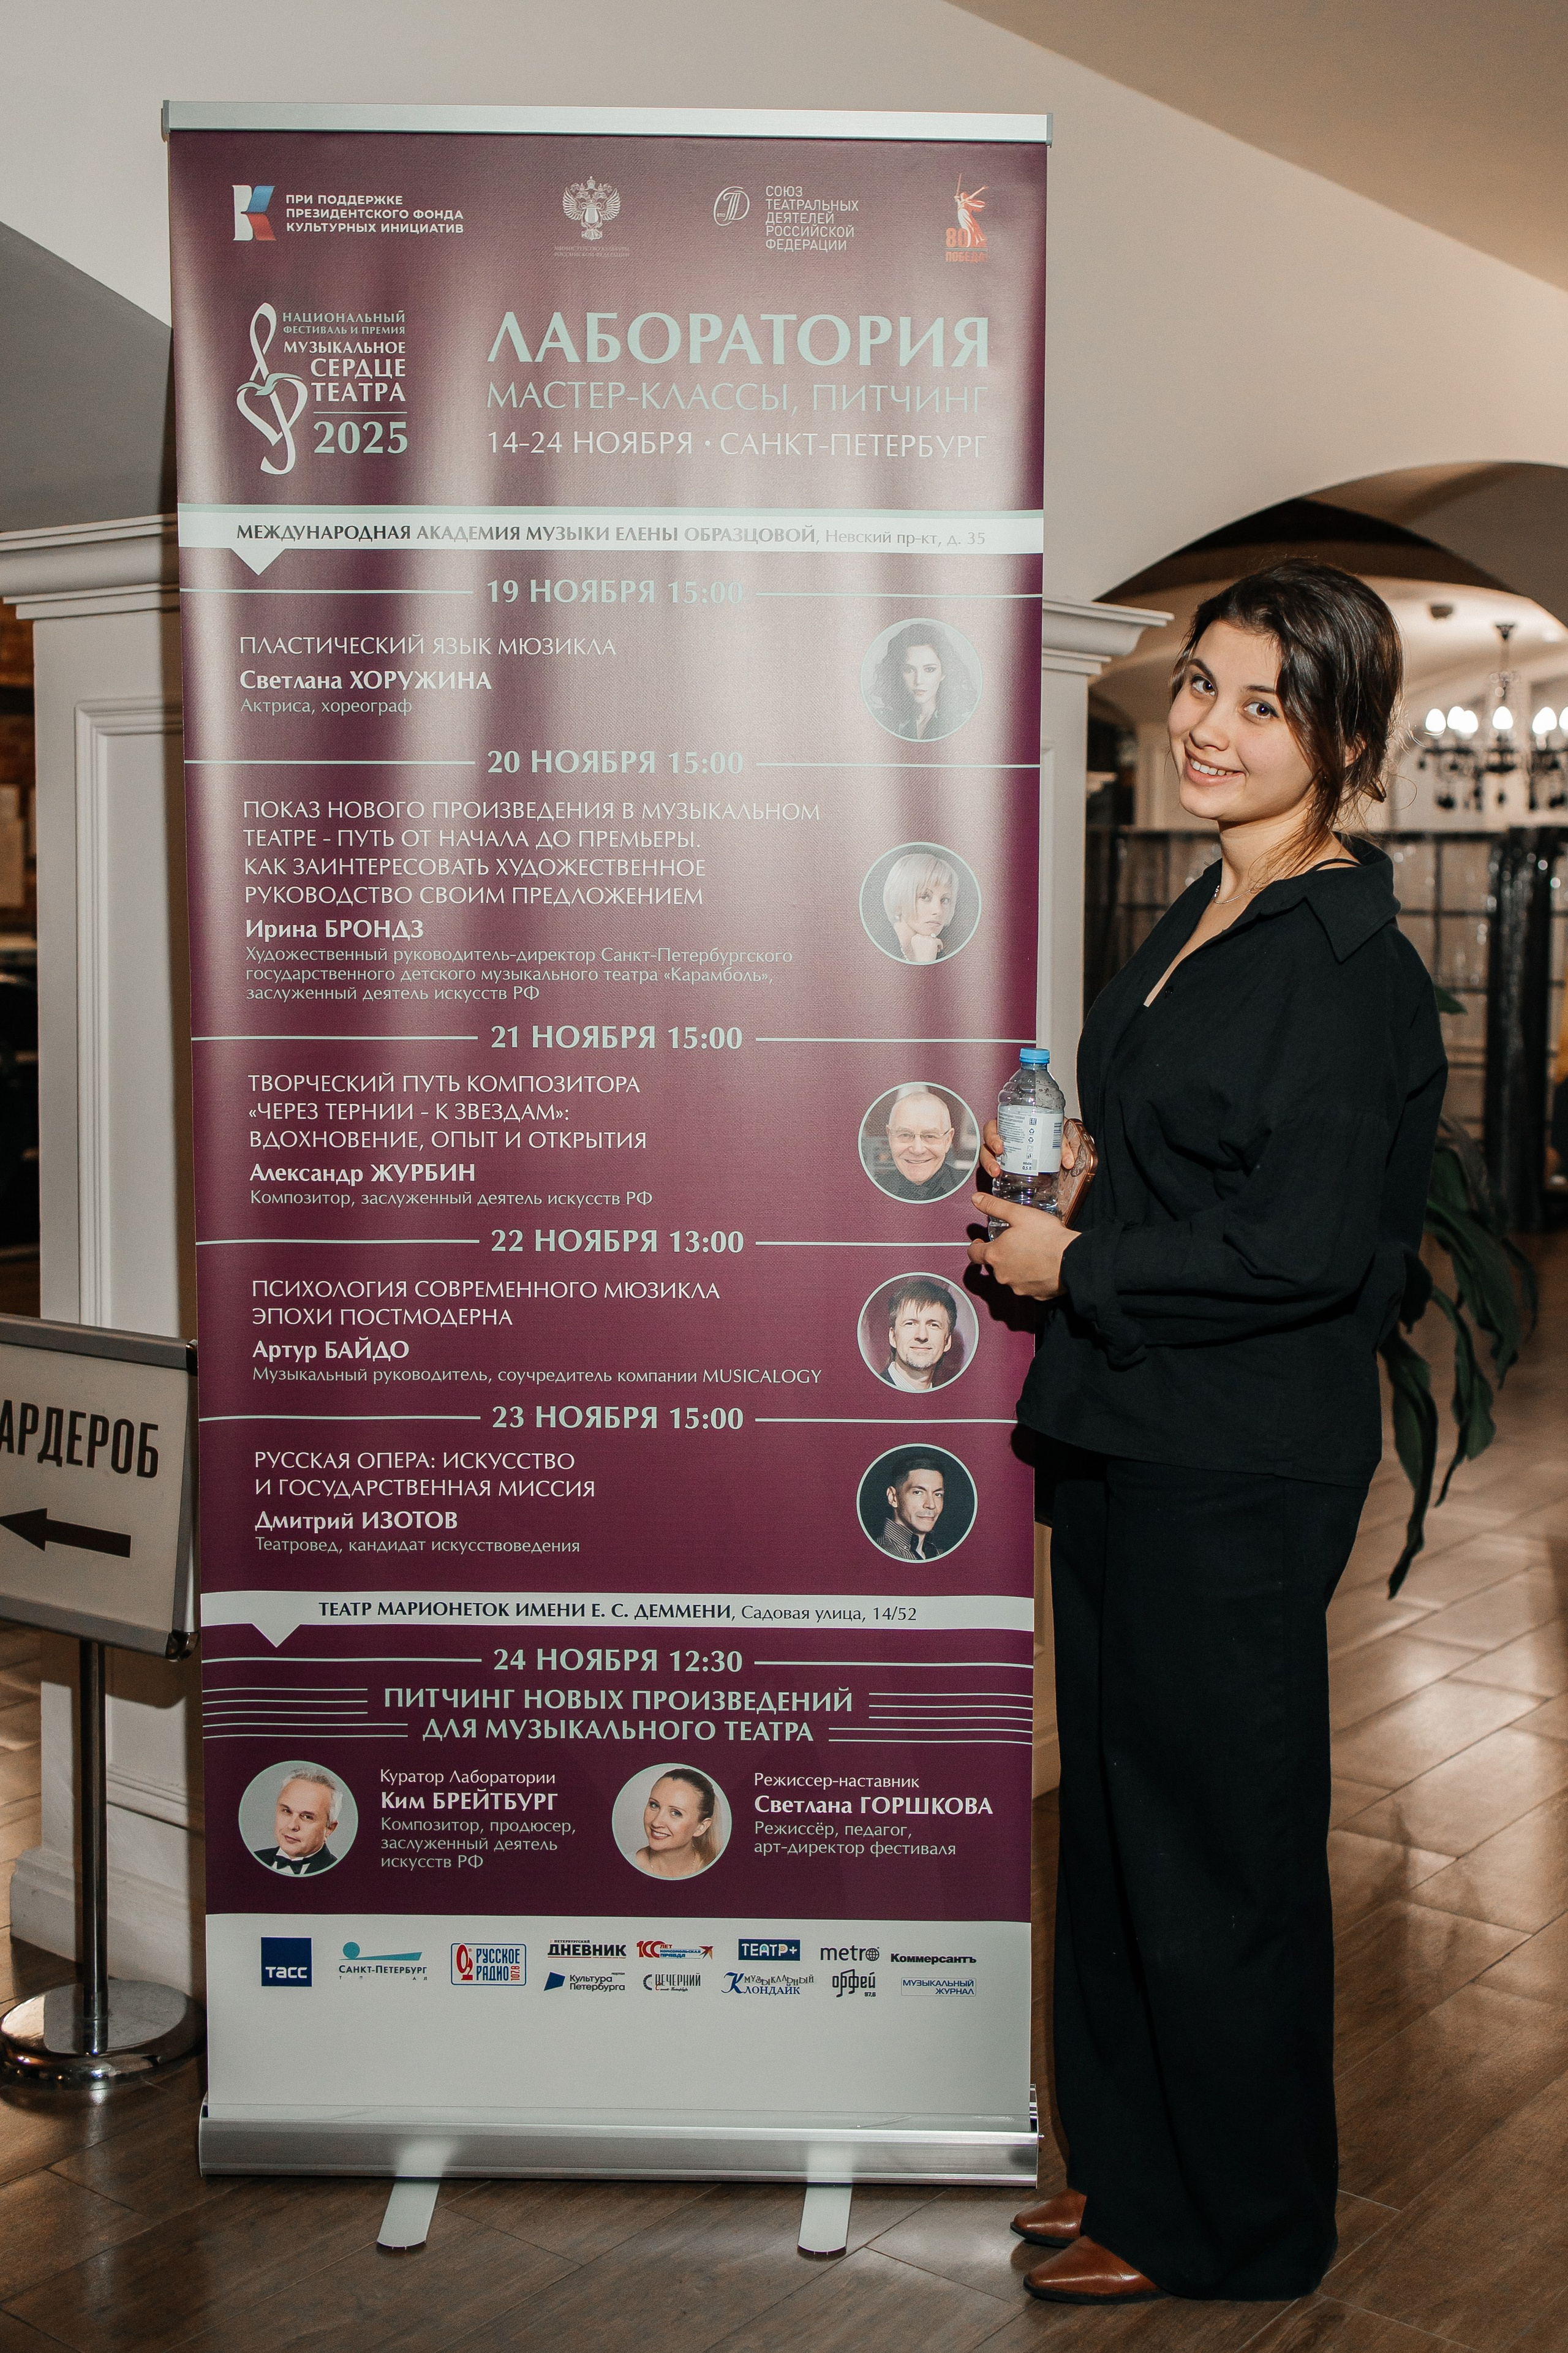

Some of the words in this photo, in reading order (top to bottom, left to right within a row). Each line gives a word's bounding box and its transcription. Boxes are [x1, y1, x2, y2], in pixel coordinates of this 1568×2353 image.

[286, 195, 312, 203] ПРИ
[318, 195, 402, 205] ПОДДЕРЖКЕ
[766, 186, 802, 197] СОЮЗ
[287, 208, 409, 219] ПРЕЗИДЕНТСКОГО
[413, 210, 463, 220] ФОНДА
[766, 198, 858, 213] ТЕАТРАЛЬНЫХ
[765, 211, 834, 225] ДЕЯТЕЛЕЙ
[287, 223, 376, 232] КУЛЬТУРНЫХ
[381, 224, 463, 234] ИНИЦИАТИВ
[766, 225, 854, 237] РОССИЙСКОЙ
[766, 239, 846, 252] ФЕДЕРАЦИИ
[283, 310, 404, 322] НАЦИОНАЛЬНЫЙ
[284, 341, 405, 353] МУЗЫКАЛЬНОЕ
[488, 312, 988, 369] ЛАБОРАТОРИЯ
[311, 358, 405, 379] СЕРДЦЕ
[311, 383, 405, 401] ТЕАТРА
[488, 381, 797, 416] МАСТЕР-КЛАССЫ,
[813, 384, 988, 414] ПИТЧИНГ
[314, 421, 407, 453] 2025
[489, 431, 562, 453] 14-24
[575, 431, 692, 454] НОЯБРЯ
[720, 432, 987, 458] САНКТ-ПЕТЕРБУРГ
[237, 525, 410, 541] МЕЖДУНАРОДНАЯ
[417, 526, 519, 541] АКАДЕМИЯ
[527, 527, 609, 541] МУЗЫКИ
[616, 527, 677, 541] ЕЛЕНЫ
[685, 525, 819, 545] ОБРАЗЦОВОЙ,
[826, 530, 891, 543] Невский
[897, 534, 941, 547] пр-кт,
[947, 535, 961, 546] д.
[968, 532, 985, 545] 35
[488, 580, 518, 602] 19
[531, 580, 654, 603] НОЯБРЯ
[669, 580, 745, 603] 15:00
[241, 635, 423, 654] ПЛАСТИЧЕСКИЙ
[433, 638, 491, 654] ЯЗЫК
[499, 638, 616, 655] МЮЗИКЛА
[241, 670, 342, 689] Светлана
[350, 671, 492, 689] ХОРУЖИНА
[241, 699, 315, 715] Актриса,
[322, 699, 412, 716] хореограф
[244, 801, 320, 818] ПОКАЗ
[328, 801, 424, 818] НОВОГО
[433, 802, 613, 821] ПРОИЗВЕДЕНИЯ
[623, 803, 634, 818] В
[643, 803, 820, 820] МУЗЫКАЛЬНОМ
[247, 920, 317, 942] Ирина
[326, 920, 423, 940] БРОНДЗ
[246, 947, 387, 964] Художественный
[394, 951, 595, 965] руководитель-директор
[601, 947, 793, 965] Санкт-Петербургского
[247, 970, 395, 983] государственного
[401, 970, 476, 981] детского
[481, 970, 598, 983] музыкального
[604, 971, 658, 984] театра
[664, 967, 772, 984] «Карамболь»,
[248, 1072, 394, 1092] ТВОРЧЕСКИЙ
[404, 1075, 460, 1092] ПУТЬ
[468, 1075, 640, 1093] КОМПОЗИТОРА
[249, 1103, 318, 1120] «ЧЕРЕЗ
[325, 1103, 413, 1120] ТЕРНИИ
[436, 1103, 448, 1119] К
[455, 1103, 568, 1122] ЗВЕЗДАМ»:
[250, 1164, 363, 1185] Александр
[371, 1164, 475, 1182] ЖУРБИН
[492, 1229, 522, 1251] 22
[535, 1229, 657, 1252] НОЯБРЯ
[670, 1231, 744, 1253] 13:00
[253, 1280, 407, 1297] ПСИХОЛОГИЯ
[415, 1280, 597, 1298] СОВРЕМЕННОГО
[605, 1282, 720, 1299] МЮЗИКЛА
[252, 1308, 331, 1324] ЭПОХИ
[341, 1308, 513, 1327] ПОСТМОДЕРНА
[253, 1340, 317, 1362] Артур
[325, 1337, 409, 1361] БАЙДО
[253, 1367, 367, 1383] Музыкальный
[374, 1370, 492, 1384] руководитель,
[498, 1371, 612, 1384] соучредитель
[618, 1372, 696, 1382] компании
[703, 1369, 821, 1383] MUSICALOGY
[255, 1452, 349, 1468] РУССКАЯ
[358, 1452, 434, 1469] ОПЕРА:
[443, 1452, 575, 1470] ИСКУССТВО
[255, 1511, 353, 1533] Дмитрий
[363, 1511, 457, 1528] ИЗОТОВ
[255, 1536, 342, 1554] Театровед,
[349, 1541, 426, 1552] кандидат
[432, 1541, 579, 1555] искусствоведения
[319, 1603, 371, 1615] ТЕАТР
[378, 1602, 509, 1616] МАРИОНЕТОК
[516, 1603, 584, 1617] ИМЕНИ
[592, 1604, 605, 1617] Е.
[611, 1604, 628, 1617] С.
[635, 1604, 735, 1620] ДЕММЕНИ,
[742, 1606, 809, 1620] Садовая
[815, 1610, 865, 1622] улица,
[874, 1606, 916, 1620] 14/52
[494, 1649, 526, 1670] 24
[538, 1649, 657, 1671] НОЯБРЯ
[670, 1650, 742, 1672] 12:30
[385, 1688, 514, 1708] ПИТЧИНГ
[525, 1690, 623, 1709] НОВЫХ
[633, 1688, 851, 1714] ПРОИЗВЕДЕНИЙ
[381, 1769, 444, 1786] Куратор
[450, 1769, 555, 1787] Лаборатории
[755, 1772, 919, 1790] Режиссер-наставник
[382, 1792, 424, 1808] Ким
[434, 1789, 557, 1811] БРЕЙТБУРГ
[755, 1795, 852, 1813] Светлана
[861, 1797, 993, 1815] ГОРШКОВА
[382, 1817, 483, 1834] Композитор,
[490, 1822, 575, 1835] продюсер,
[755, 1821, 838, 1838] Режиссёр,
[845, 1826, 911, 1838] педагог,
[382, 1838, 488, 1852] заслуженный
[494, 1840, 557, 1851] деятель
[754, 1843, 864, 1857] арт-директор
[870, 1841, 956, 1857] фестиваля
[382, 1858, 451, 1871] искусств
[458, 1854, 483, 1868] РФ
[476, 1948, 520, 1963] РУССКОЕ
[548, 1944, 627, 1957] ДНЕВНИК
[891, 1953, 977, 1964] Коммерсантъ
[476, 1965, 508, 1981] РАДИО
[510, 1965, 521, 1981] 107.8
[570, 1974, 612, 1983] Культура
[655, 1973, 701, 1986] ВЕЧЕРНИЙ
[570, 1983, 625, 1992] Петербурга
[902, 1977, 974, 1988] МУЗЫКАЛЬНЫЙ
